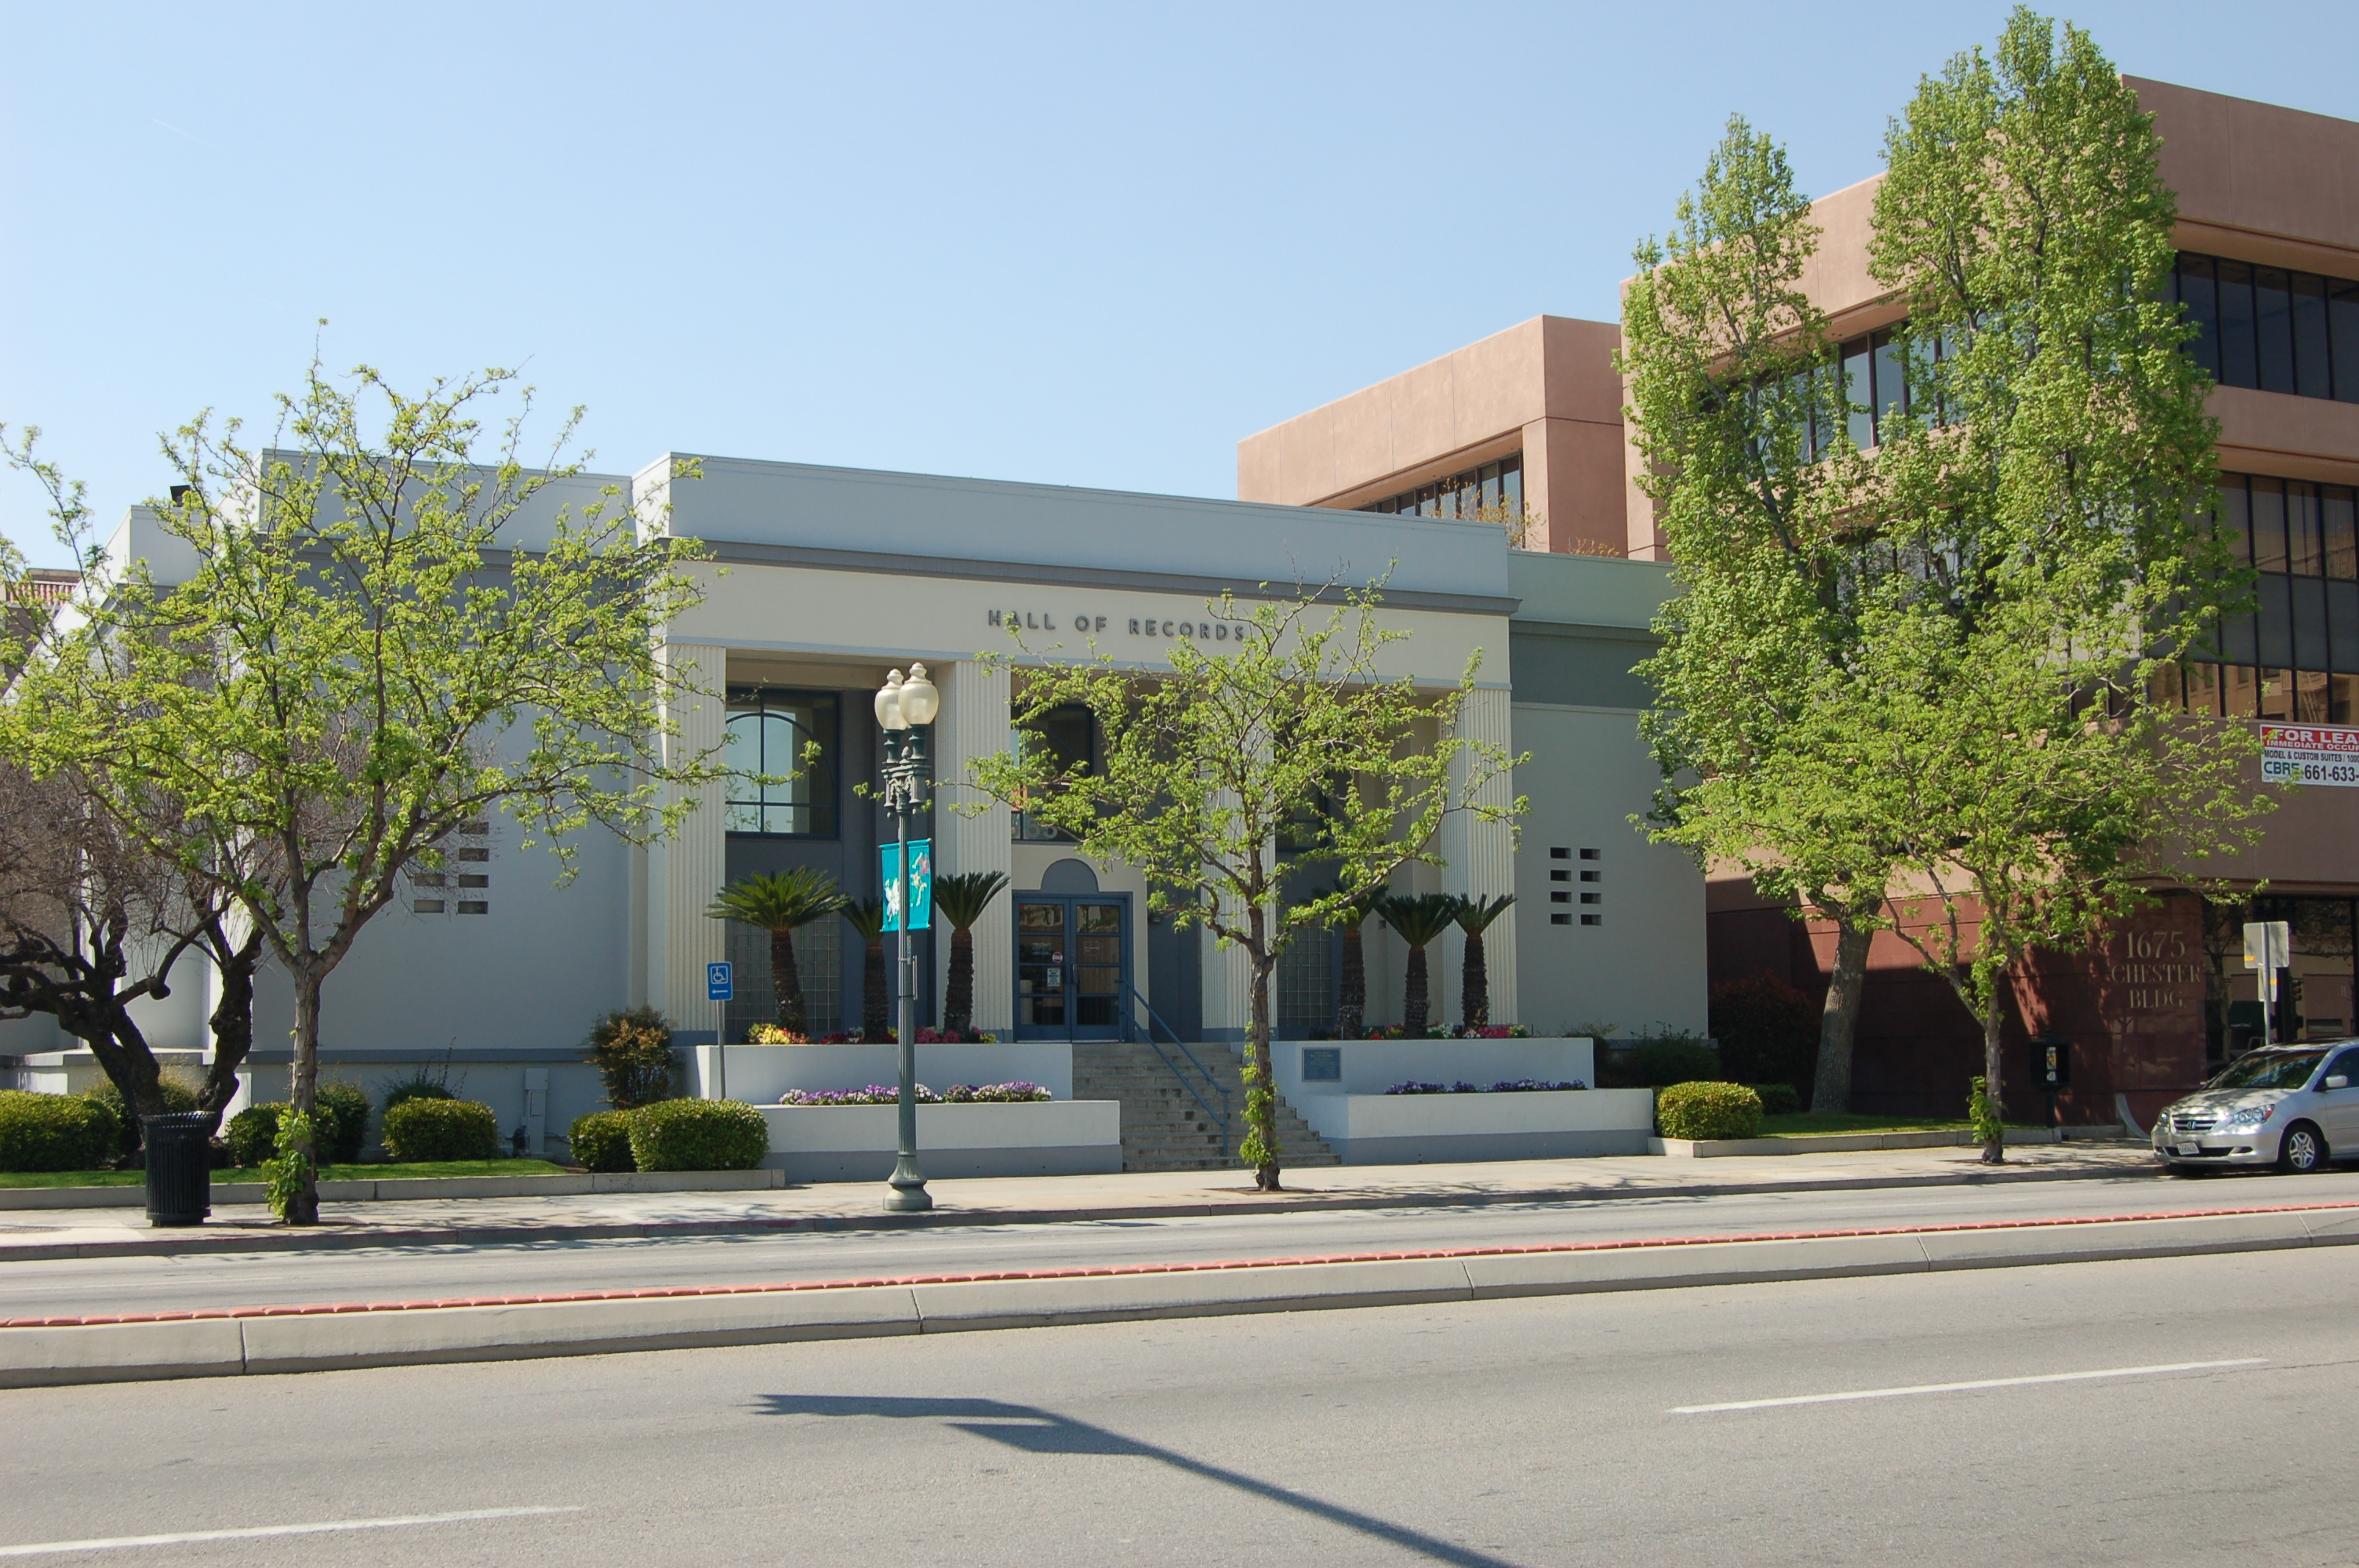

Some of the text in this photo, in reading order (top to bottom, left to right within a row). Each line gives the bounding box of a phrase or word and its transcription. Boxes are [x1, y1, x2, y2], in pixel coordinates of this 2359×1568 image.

[988, 609, 1245, 641] HALL OF RECORDS
[2266, 739, 2323, 750] IMMEDIATE
[2274, 729, 2359, 744] FOR LEA
[2264, 750, 2286, 759] MODEL
[2287, 750, 2292, 759] &
[2294, 751, 2319, 760] CUSTOM
[2321, 753, 2342, 762] SUITES
[2126, 930, 2186, 959] 1675
[2111, 964, 2201, 983] CHESTER
